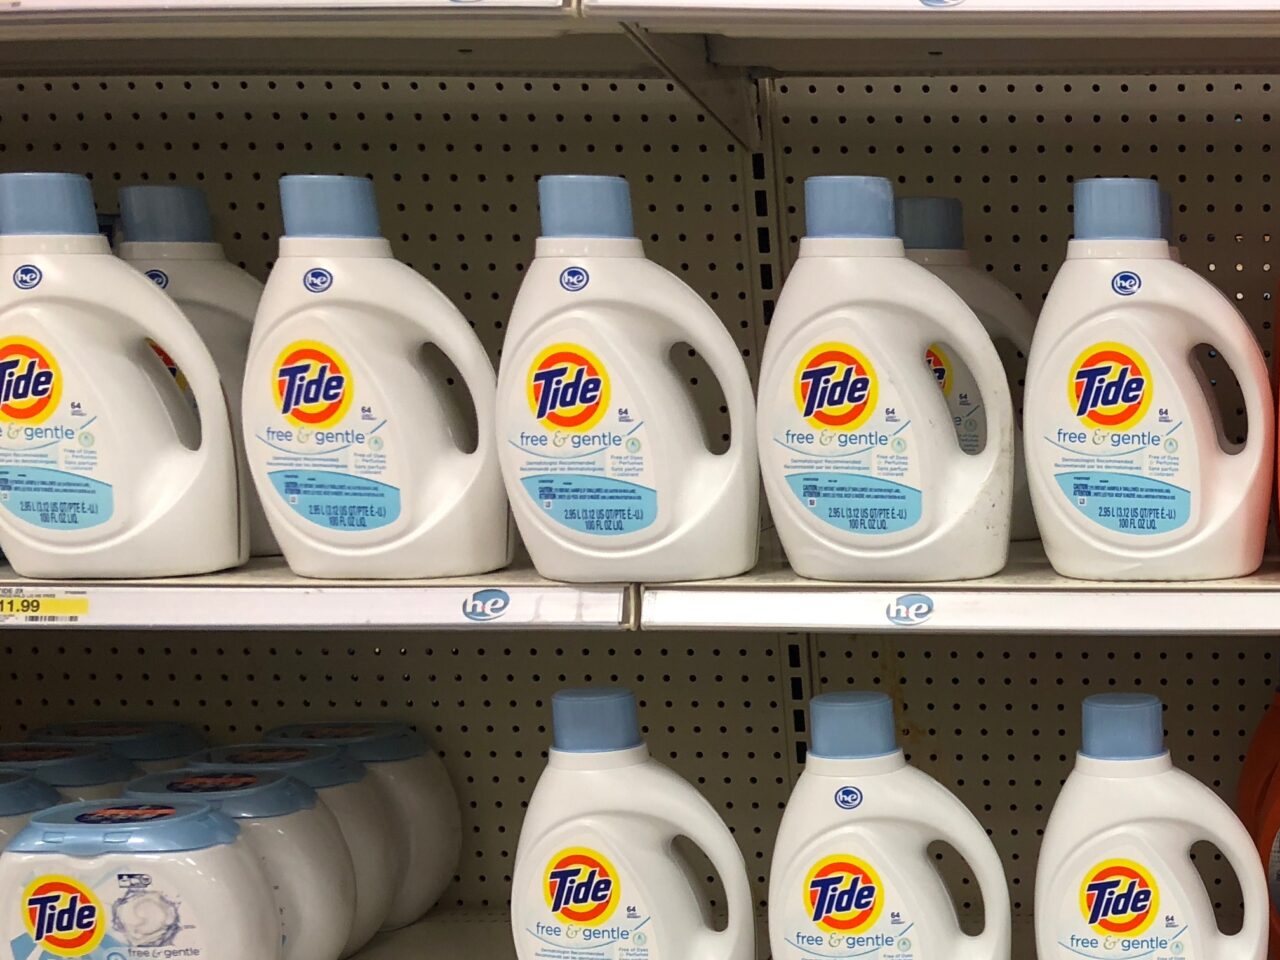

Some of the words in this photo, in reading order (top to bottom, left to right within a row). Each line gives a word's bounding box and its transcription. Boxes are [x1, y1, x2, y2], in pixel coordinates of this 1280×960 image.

[278, 364, 343, 414] Tide
[533, 366, 601, 419] Tide
[801, 366, 869, 417] Tide
[1075, 365, 1144, 416] Tide
[520, 433, 547, 445] free
[572, 433, 622, 448] gentle
[1058, 429, 1086, 443] free
[1111, 429, 1160, 447] gentle
[0, 600, 40, 612] 11.99
[466, 592, 508, 618] he
[888, 597, 931, 623] he
[549, 867, 611, 911] Tide
[811, 876, 873, 921] Tide
[1087, 878, 1151, 924] Tide
[28, 896, 95, 941] Tide
[1071, 936, 1098, 948] free
[1121, 936, 1167, 951] gentle
